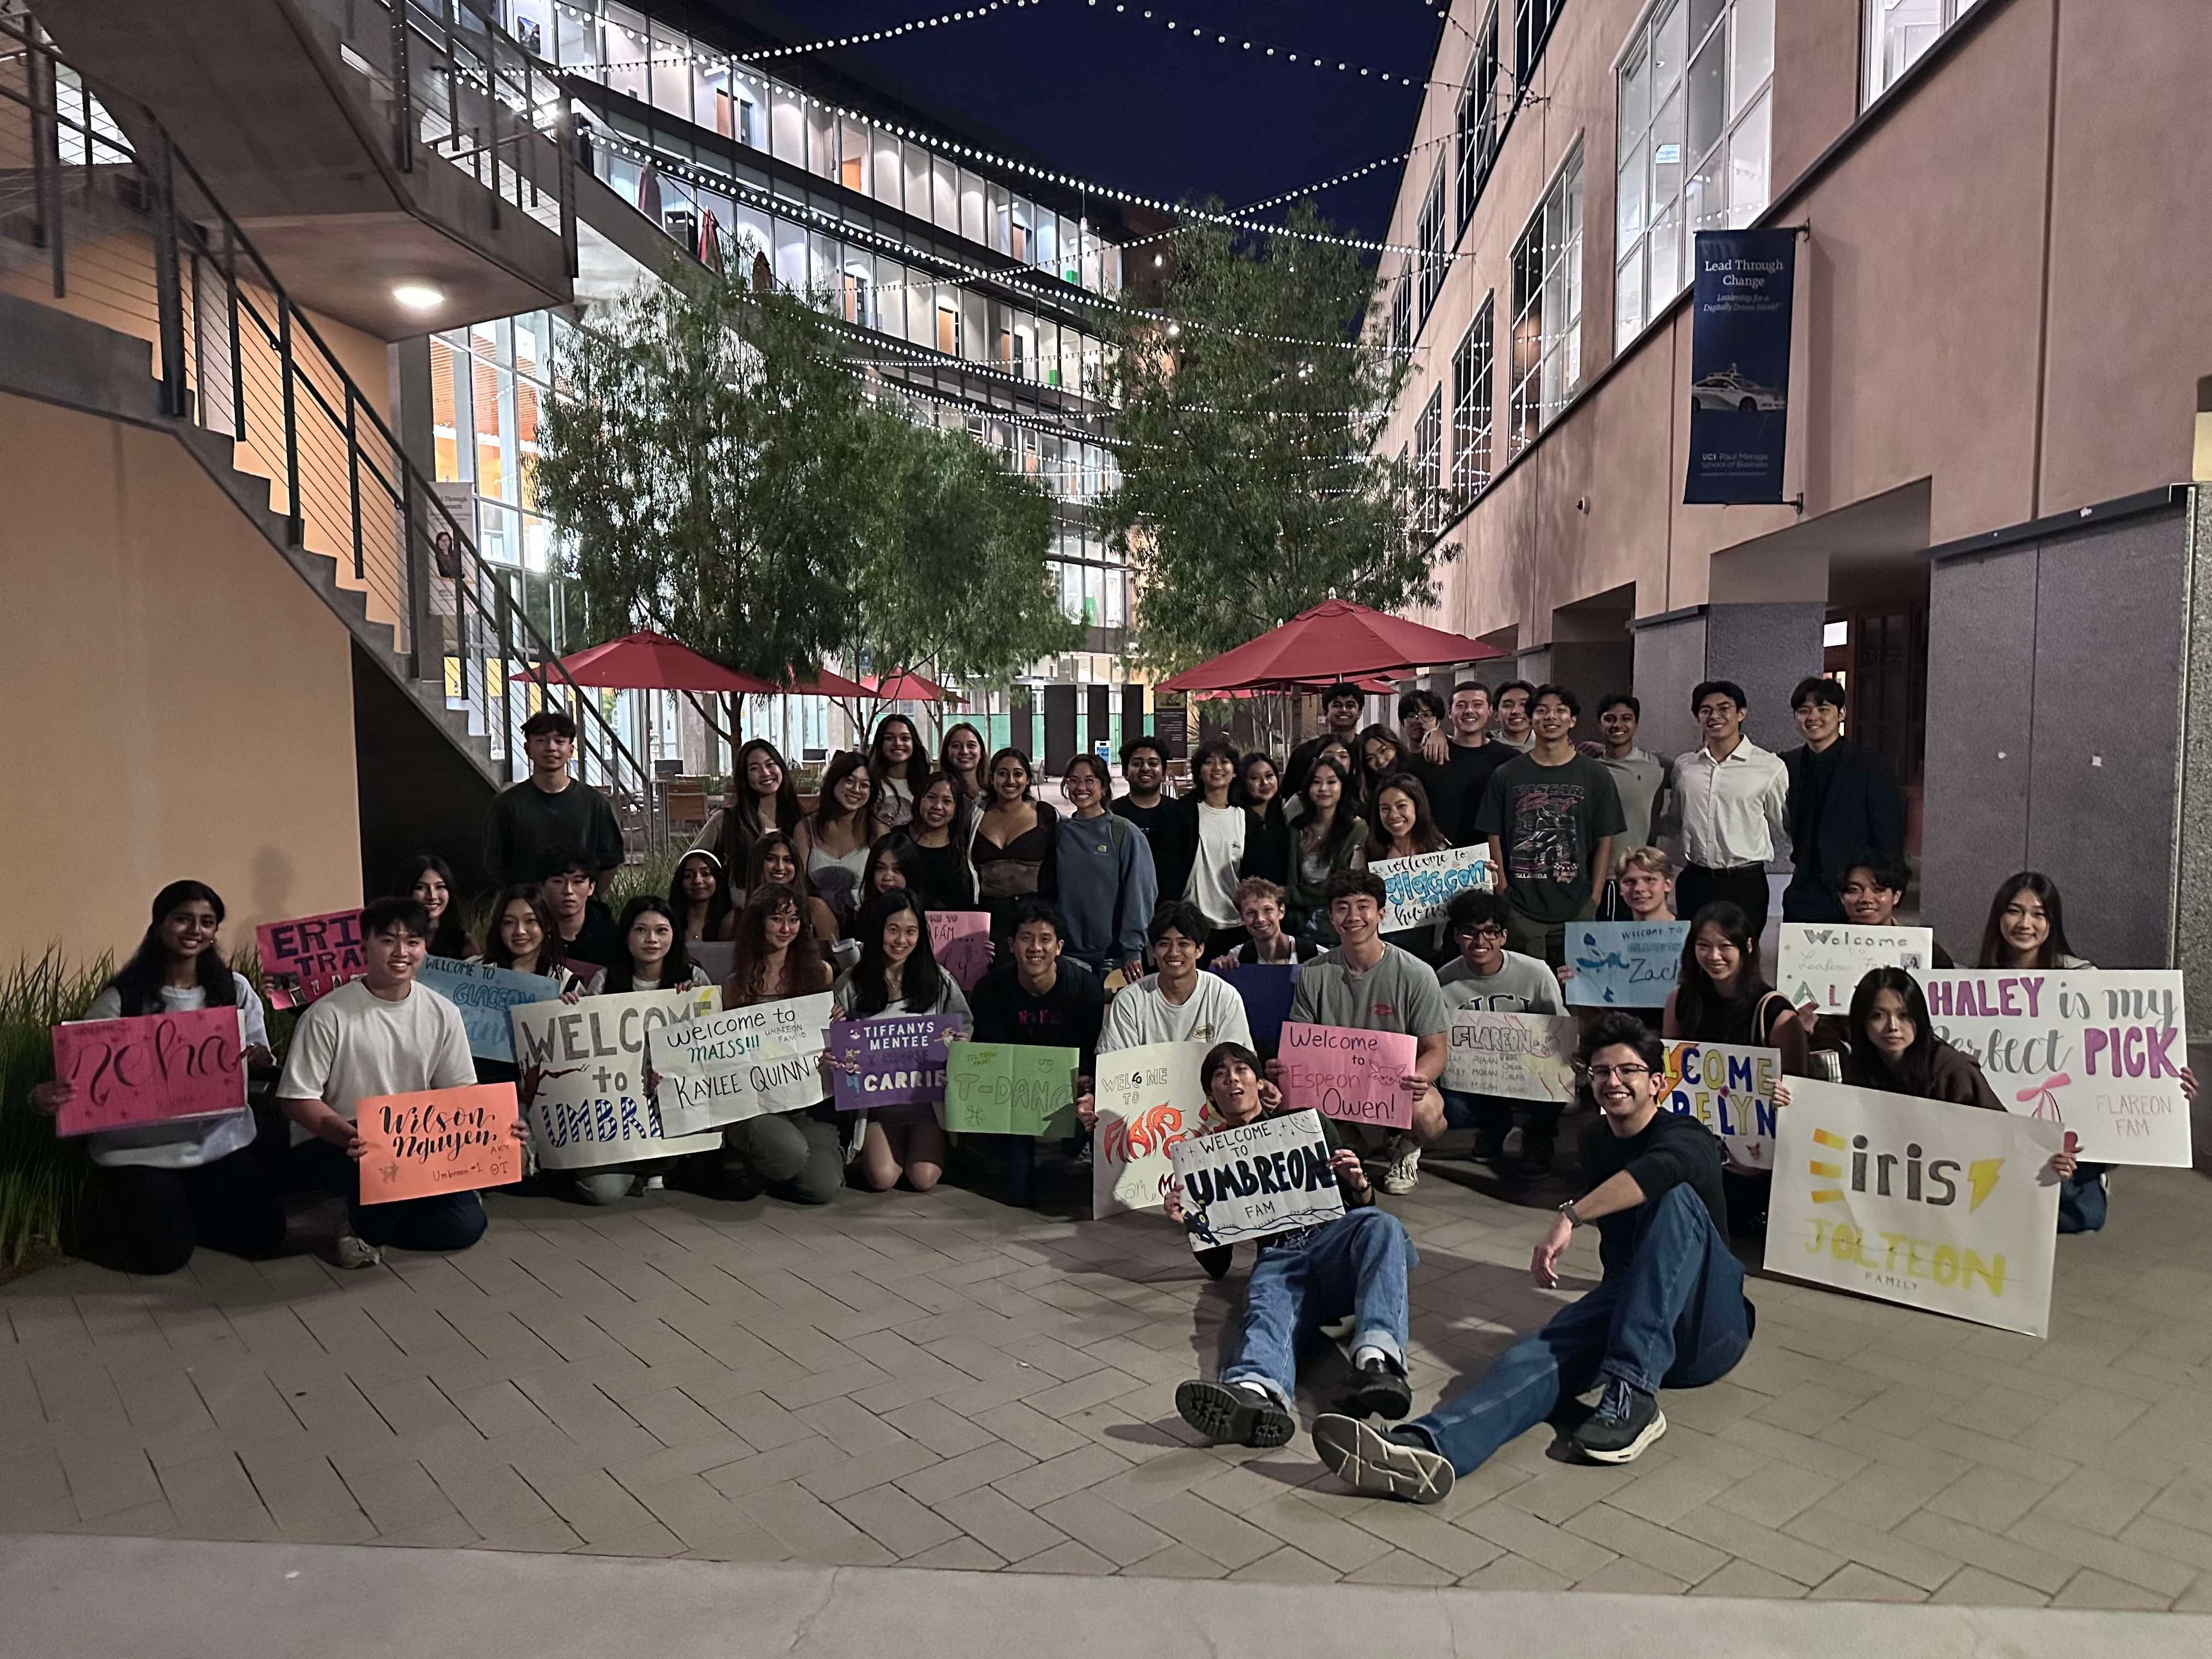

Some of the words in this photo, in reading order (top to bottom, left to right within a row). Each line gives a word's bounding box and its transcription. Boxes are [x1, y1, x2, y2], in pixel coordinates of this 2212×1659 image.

[1705, 259, 1732, 271] Lead
[1734, 259, 1784, 274] Through
[1722, 274, 1765, 289] Change
[1702, 453, 1717, 461] UCI
[1513, 784, 1583, 796] NASCAR
[1388, 854, 1446, 873] welcome
[1455, 850, 1465, 861] to
[271, 914, 361, 960] ERI
[1804, 929, 1908, 947] Welcome
[294, 947, 368, 977] TRA
[425, 957, 475, 977] WELCOME
[482, 965, 496, 980] TO
[1927, 976, 2045, 1018] HALEY
[2059, 980, 2090, 1020] is
[2101, 988, 2178, 1036] my
[667, 1011, 767, 1048] welcome
[772, 1007, 796, 1025] to
[764, 1024, 803, 1036] UMBREON
[778, 1035, 797, 1043] FAM
[863, 1021, 935, 1039] TIFFANYS
[1290, 1026, 1378, 1052] Welcome
[1452, 1025, 1532, 1052] FLAREON
[870, 1035, 929, 1051] MENTEE
[2084, 1027, 2180, 1079] PICK
[1351, 1053, 1365, 1066] to
[1662, 1045, 1774, 1097] LCOME
[592, 1066, 628, 1093] to
[674, 1073, 743, 1109] KAYLEE
[749, 1056, 810, 1094] QUINN
[863, 1069, 946, 1092] CARRIE
[1290, 1065, 1361, 1096] Espeon
[1123, 1092, 1140, 1105] TO
[1322, 1088, 1395, 1120] Owen!
[2095, 1094, 2171, 1115] FLAREON
[378, 1104, 496, 1135] Wilson
[541, 1097, 661, 1148] UMBR
[2115, 1118, 2150, 1138] FAM
[392, 1130, 497, 1165] Nguyen
[1199, 1123, 1272, 1154] WELCOME
[1230, 1144, 1249, 1157] TO
[1184, 1140, 1336, 1207] UMBREON
[1851, 1134, 1961, 1206] iris
[1244, 1200, 1276, 1219] FAM
[1804, 1218, 2006, 1298] JOLTEON
[1865, 1271, 1918, 1290] FAMILY
